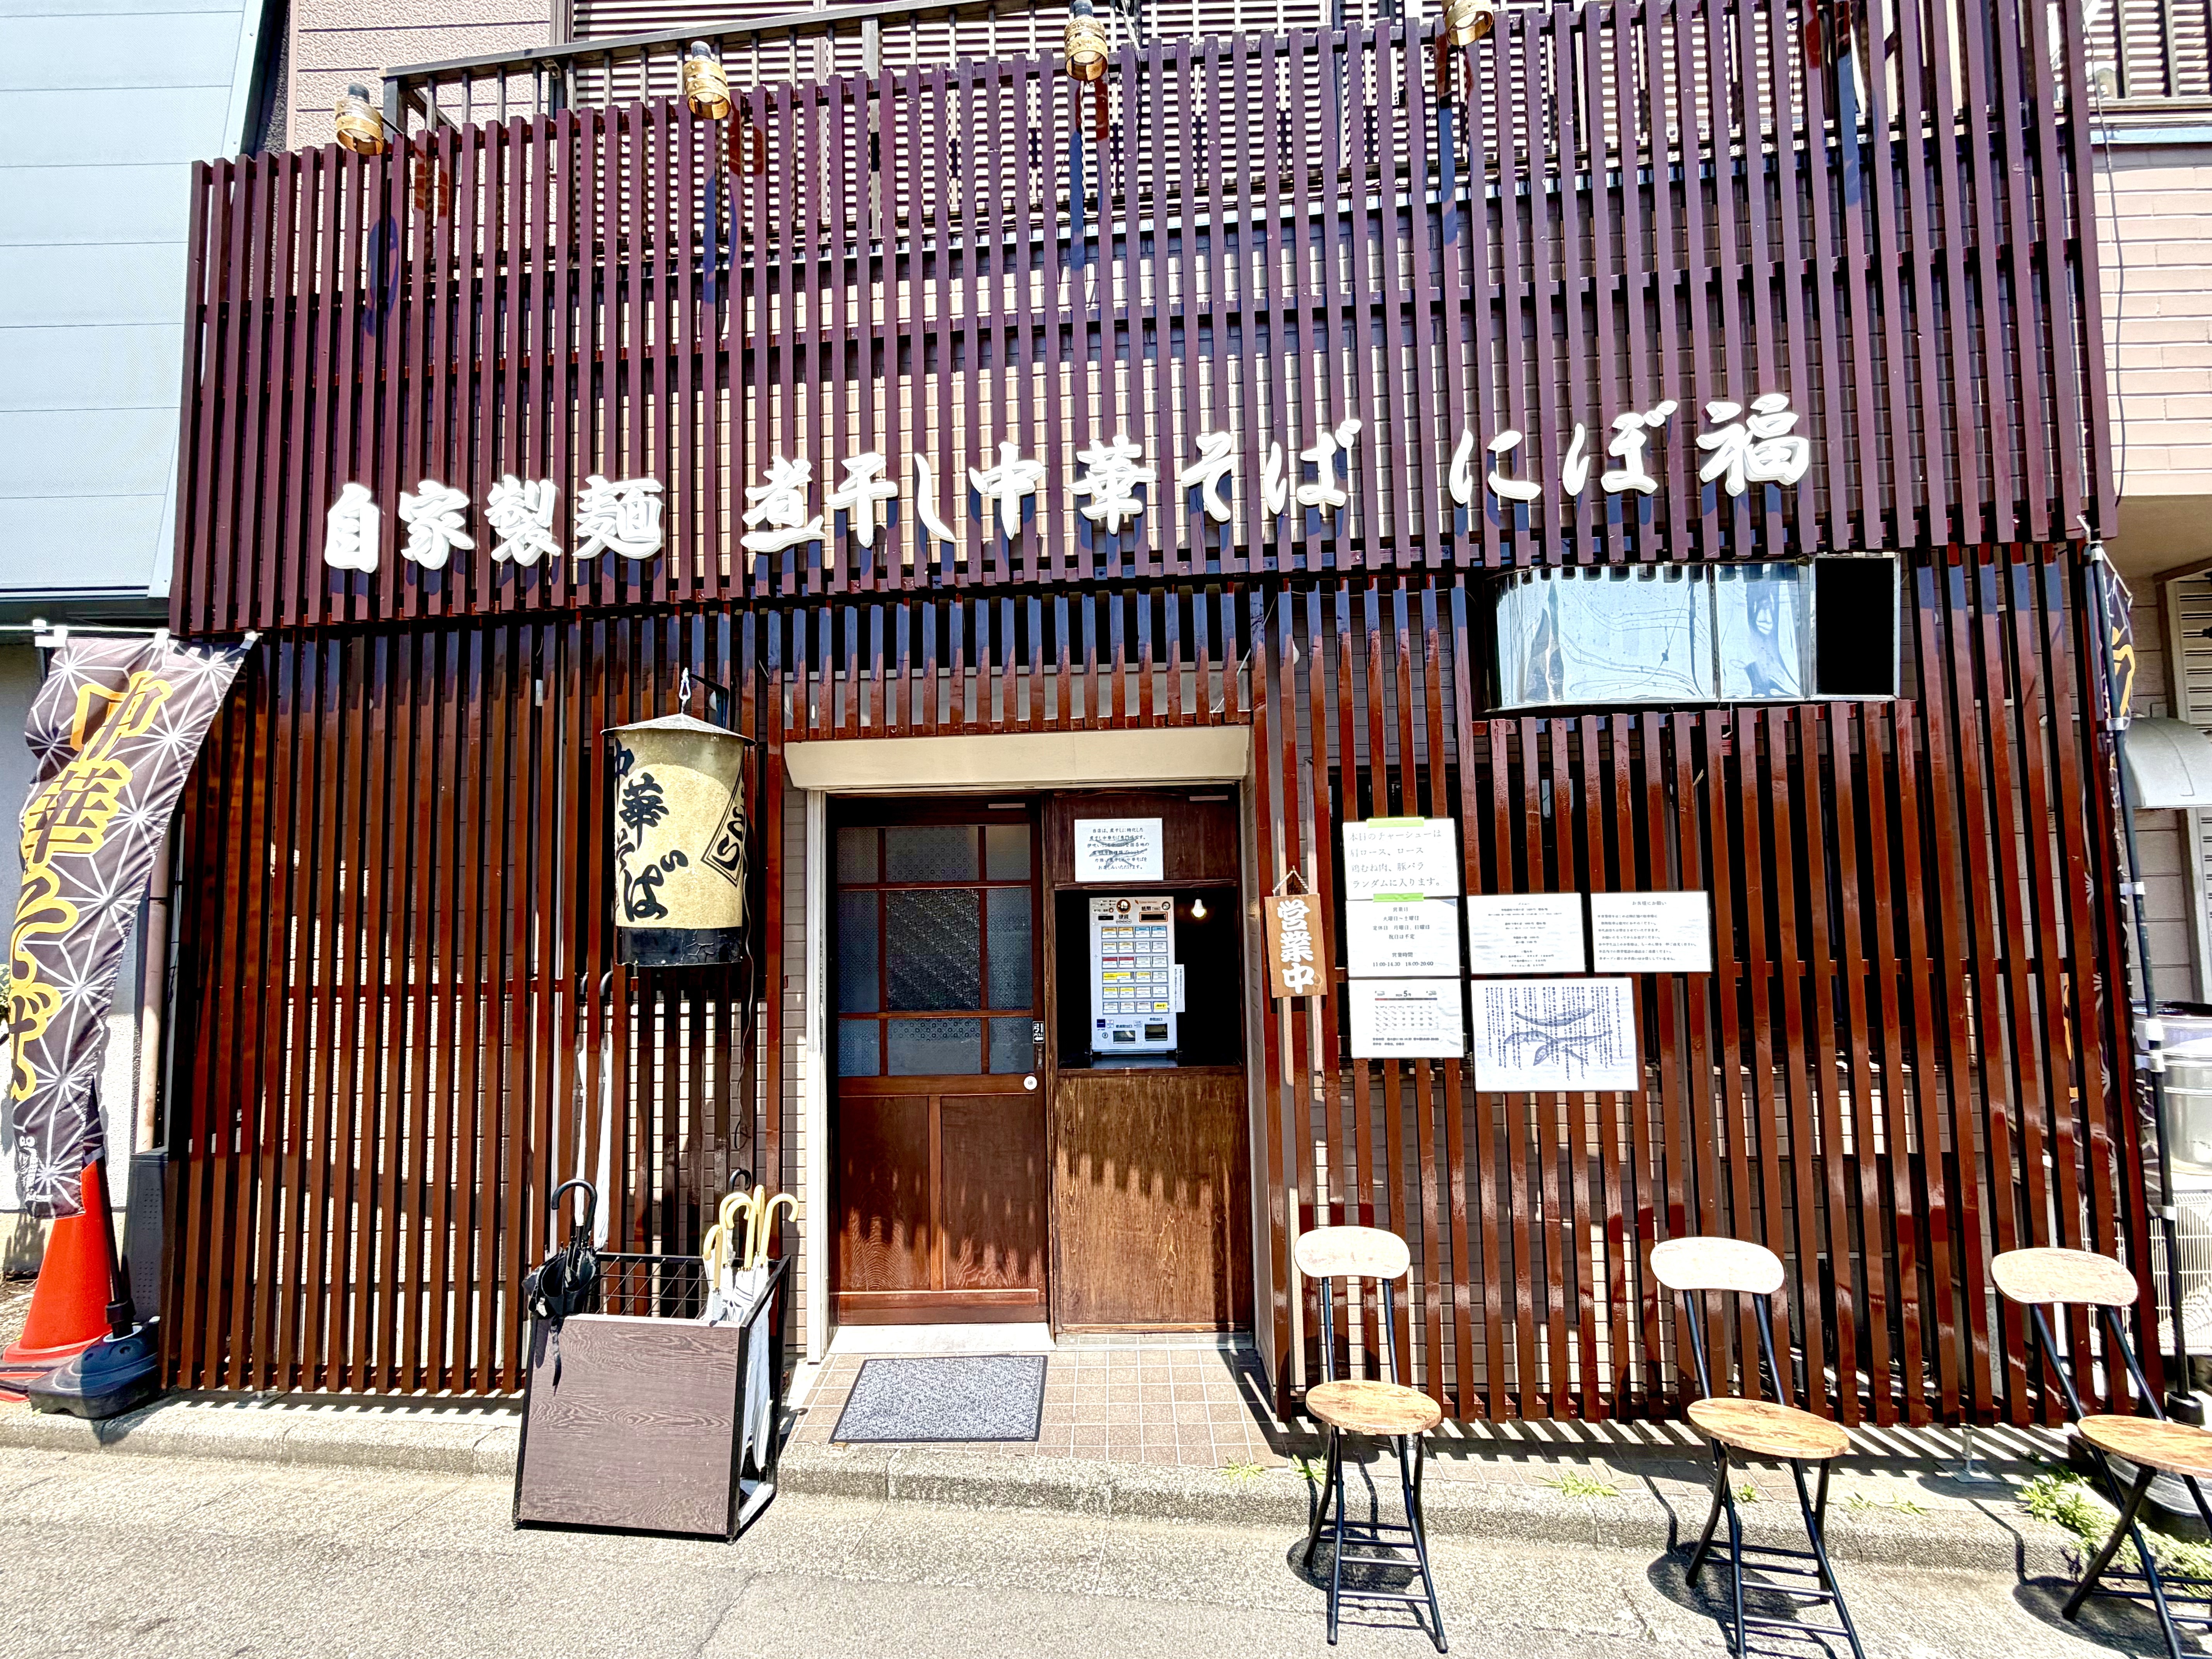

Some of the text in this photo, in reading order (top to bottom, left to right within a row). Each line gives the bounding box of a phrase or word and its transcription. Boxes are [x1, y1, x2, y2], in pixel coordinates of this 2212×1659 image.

[325, 393, 1810, 573] 自家製麺 煮干し中華そば にぼ福
[1349, 830, 1442, 842] 本日のチャーシューは
[1352, 877, 1440, 889] ランダムに入ります。
[1277, 899, 1315, 994] 営業中
[1034, 1023, 1043, 1033] 引
